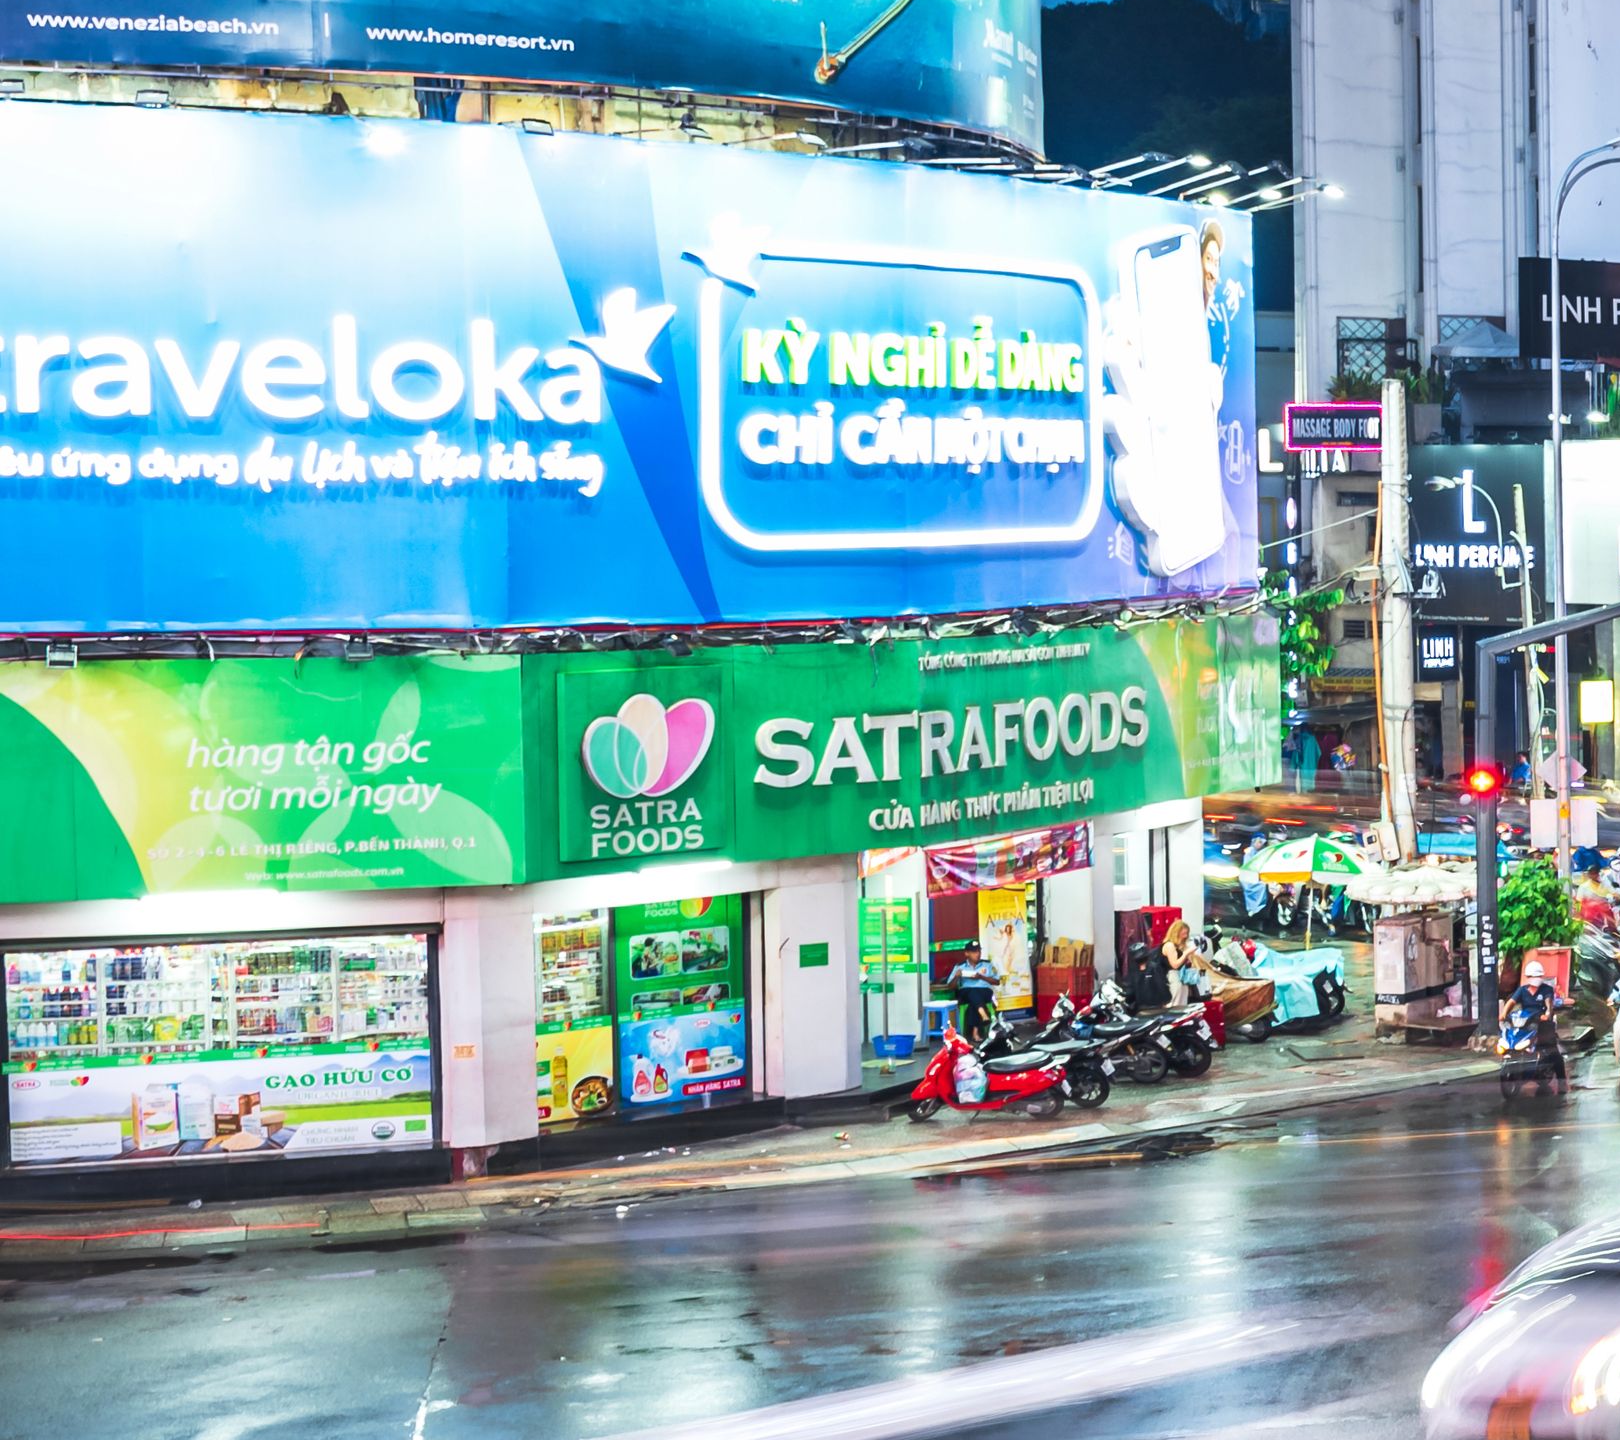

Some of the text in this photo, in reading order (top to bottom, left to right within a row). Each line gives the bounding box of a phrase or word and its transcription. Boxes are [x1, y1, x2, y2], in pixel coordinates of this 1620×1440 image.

[26, 12, 280, 36] www.veneziabeach.vn
[365, 24, 576, 54] www.homeresort.vn
[1542, 294, 1602, 324] LNH
[1292, 416, 1380, 439] MASSAGE BODY FOOT
[1423, 637, 1454, 659] LINH
[753, 685, 1150, 790] SATRAFOODS
[186, 730, 432, 776] hàng tận gốc
[188, 775, 443, 815] tươi mỗi ngày
[868, 798, 915, 831] CỬA
[919, 799, 961, 827] HÀNG
[964, 794, 1002, 821] THỰC
[1002, 782, 1040, 814] PHẨM
[590, 797, 703, 830] SATRA
[590, 824, 704, 858] FOODS
[985, 911, 1025, 929] ATHENA
[264, 1064, 413, 1092] GẠO HỮU CƠ
